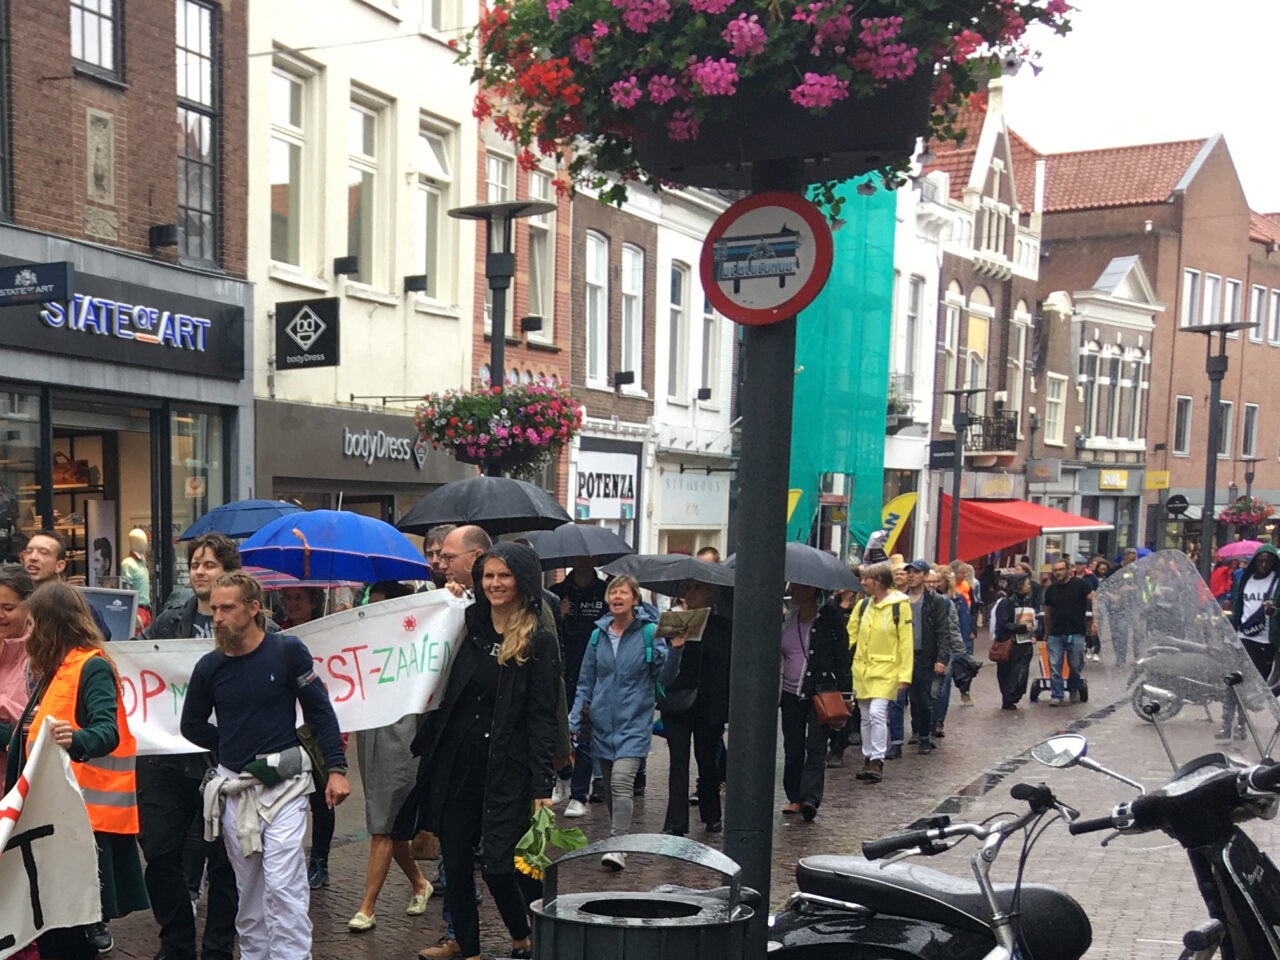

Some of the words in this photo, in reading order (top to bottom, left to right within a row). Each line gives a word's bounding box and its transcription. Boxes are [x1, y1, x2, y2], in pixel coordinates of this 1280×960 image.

[35, 284, 56, 294] ART
[40, 293, 135, 339] STATE
[132, 305, 159, 330] OF
[158, 311, 211, 352] ART
[286, 352, 326, 365] bodyDress
[344, 427, 411, 464] bodyDress
[578, 471, 634, 499] POTENZA
